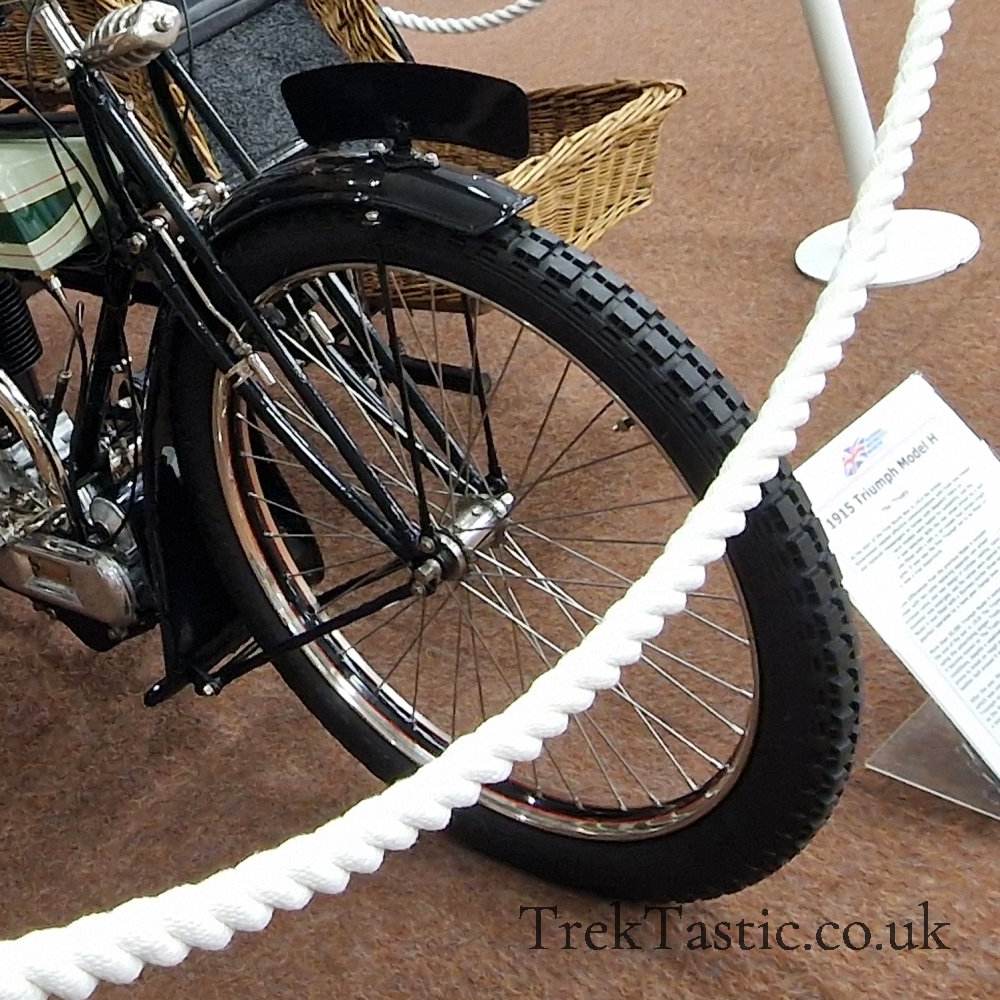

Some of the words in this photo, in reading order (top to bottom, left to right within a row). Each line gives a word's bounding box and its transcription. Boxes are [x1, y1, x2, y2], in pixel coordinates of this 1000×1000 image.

[826, 501, 856, 530] 1915
[852, 466, 900, 505] Triumph
[896, 440, 930, 470] Model
[926, 432, 939, 446] H
